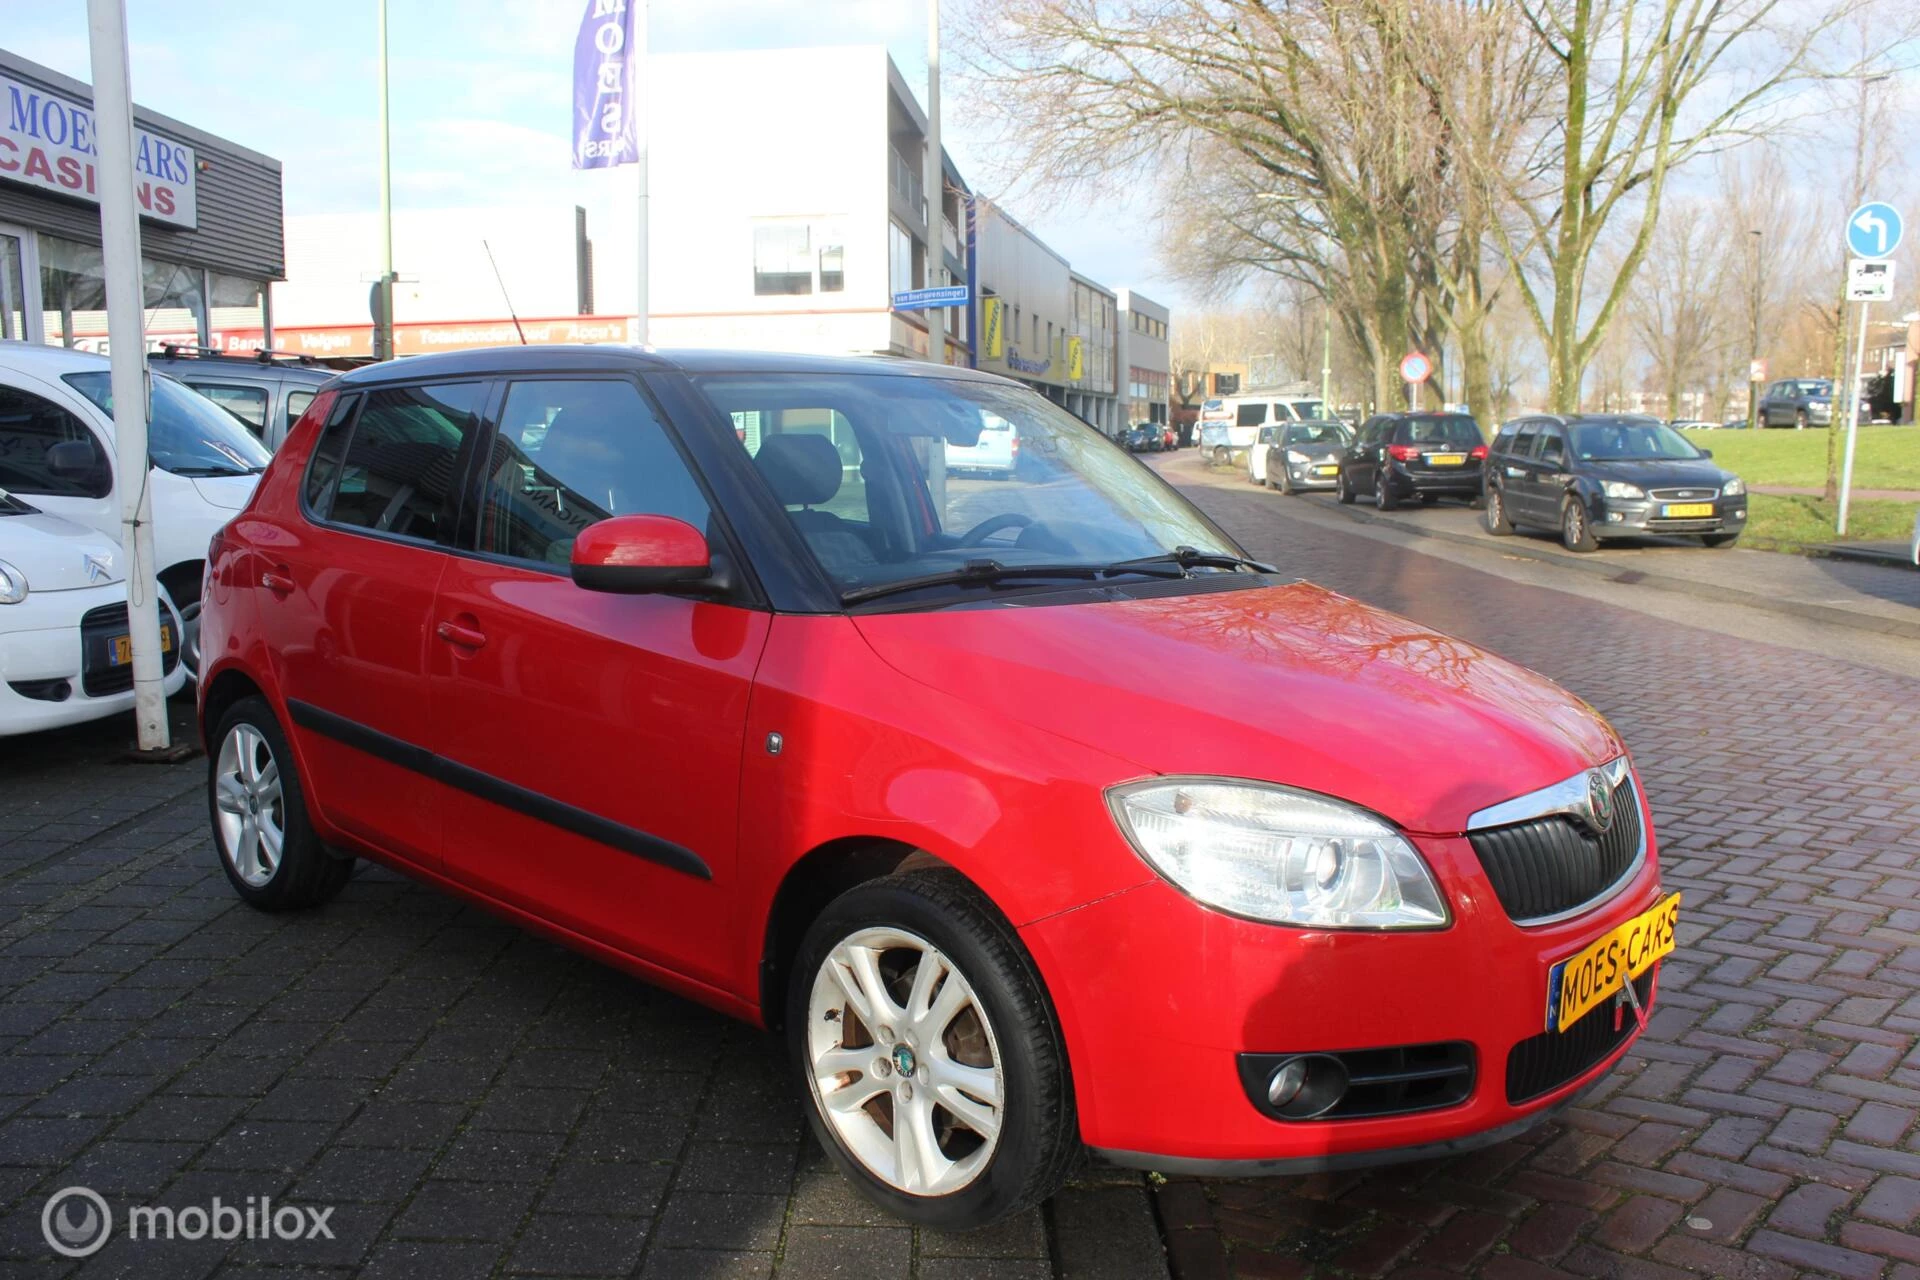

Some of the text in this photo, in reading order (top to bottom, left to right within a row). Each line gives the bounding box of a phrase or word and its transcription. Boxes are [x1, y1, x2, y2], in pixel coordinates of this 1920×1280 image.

[0, 136, 176, 216] CASINS
[136, 135, 188, 185] ARS
[229, 336, 284, 350] Bandn
[300, 333, 352, 351] Velgen
